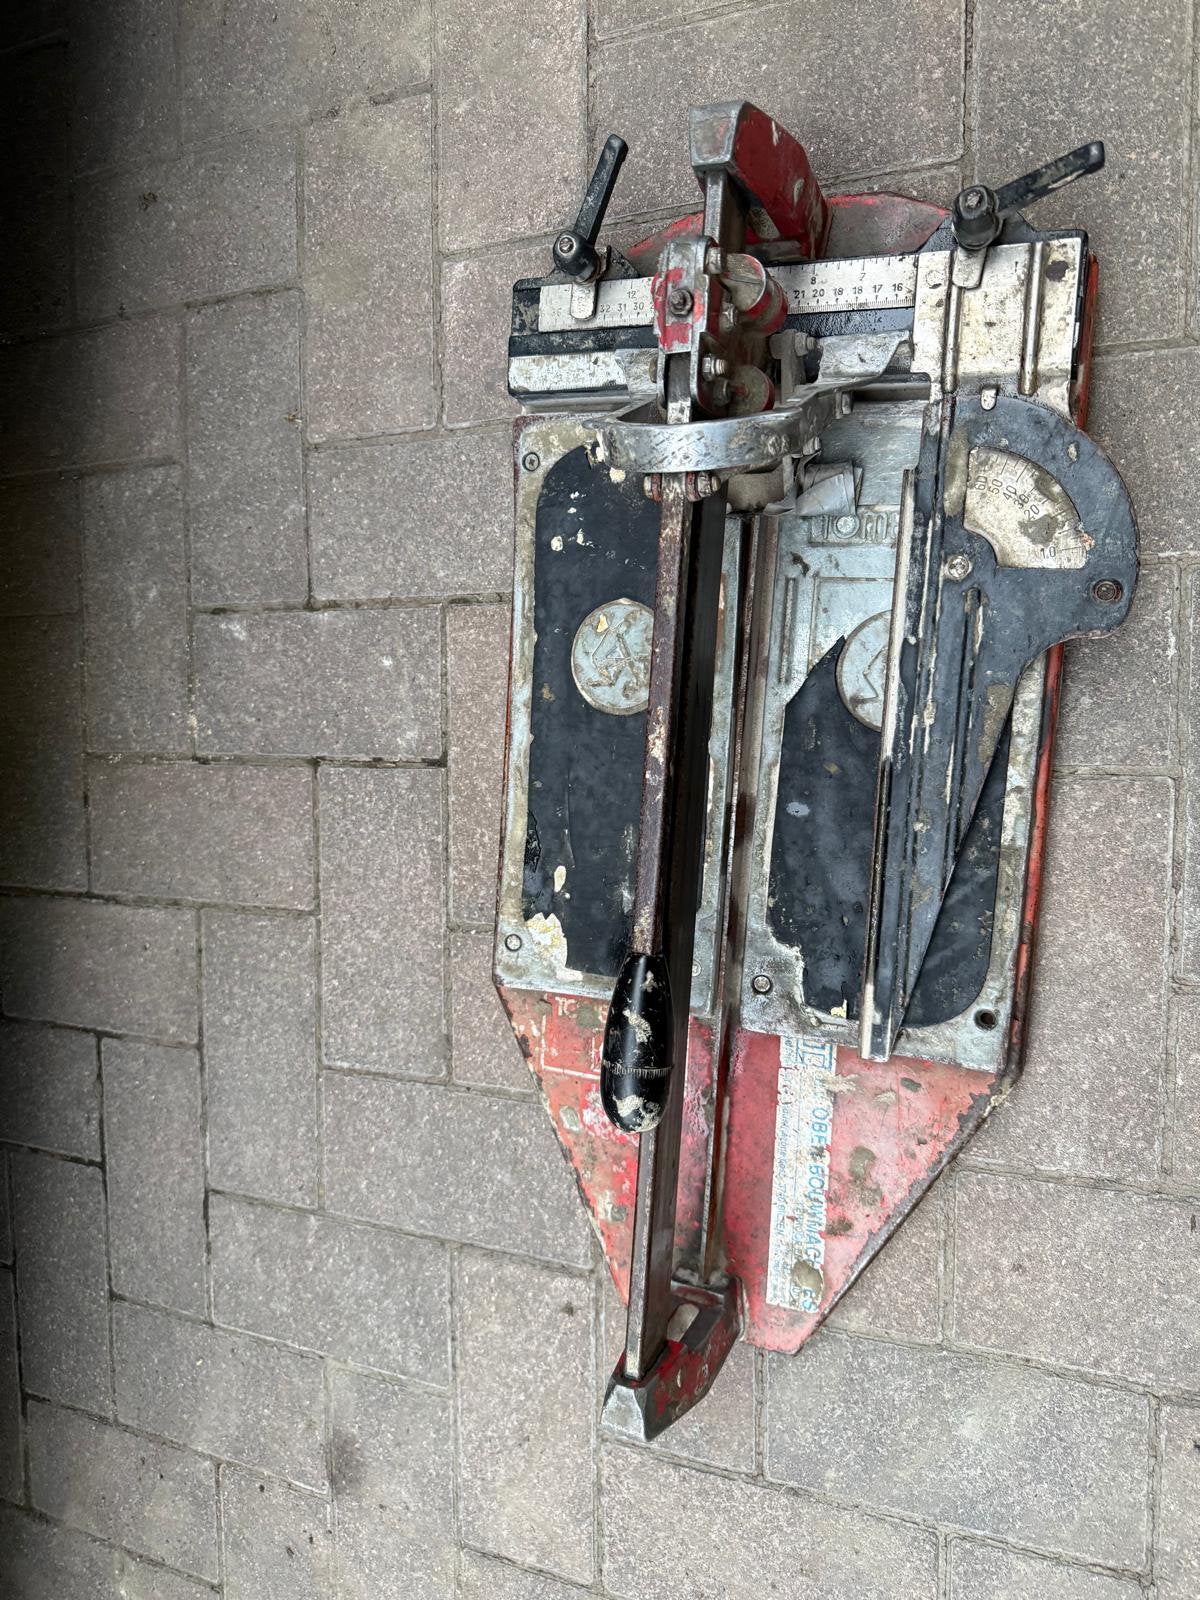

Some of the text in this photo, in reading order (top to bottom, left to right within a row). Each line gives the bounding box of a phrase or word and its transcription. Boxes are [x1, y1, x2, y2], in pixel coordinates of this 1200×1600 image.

[600, 304, 611, 312] 32
[617, 303, 627, 312] 31
[633, 302, 645, 311] 30
[793, 290, 805, 299] 21
[812, 288, 825, 298] 20
[872, 284, 883, 293] 17
[892, 283, 903, 292] 16
[975, 475, 988, 491] 60
[988, 478, 1003, 495] 50
[1002, 485, 1017, 501] 40
[1023, 504, 1040, 520] 20
[1040, 546, 1056, 559] 10
[802, 1164, 826, 1311] BOUWMACES
